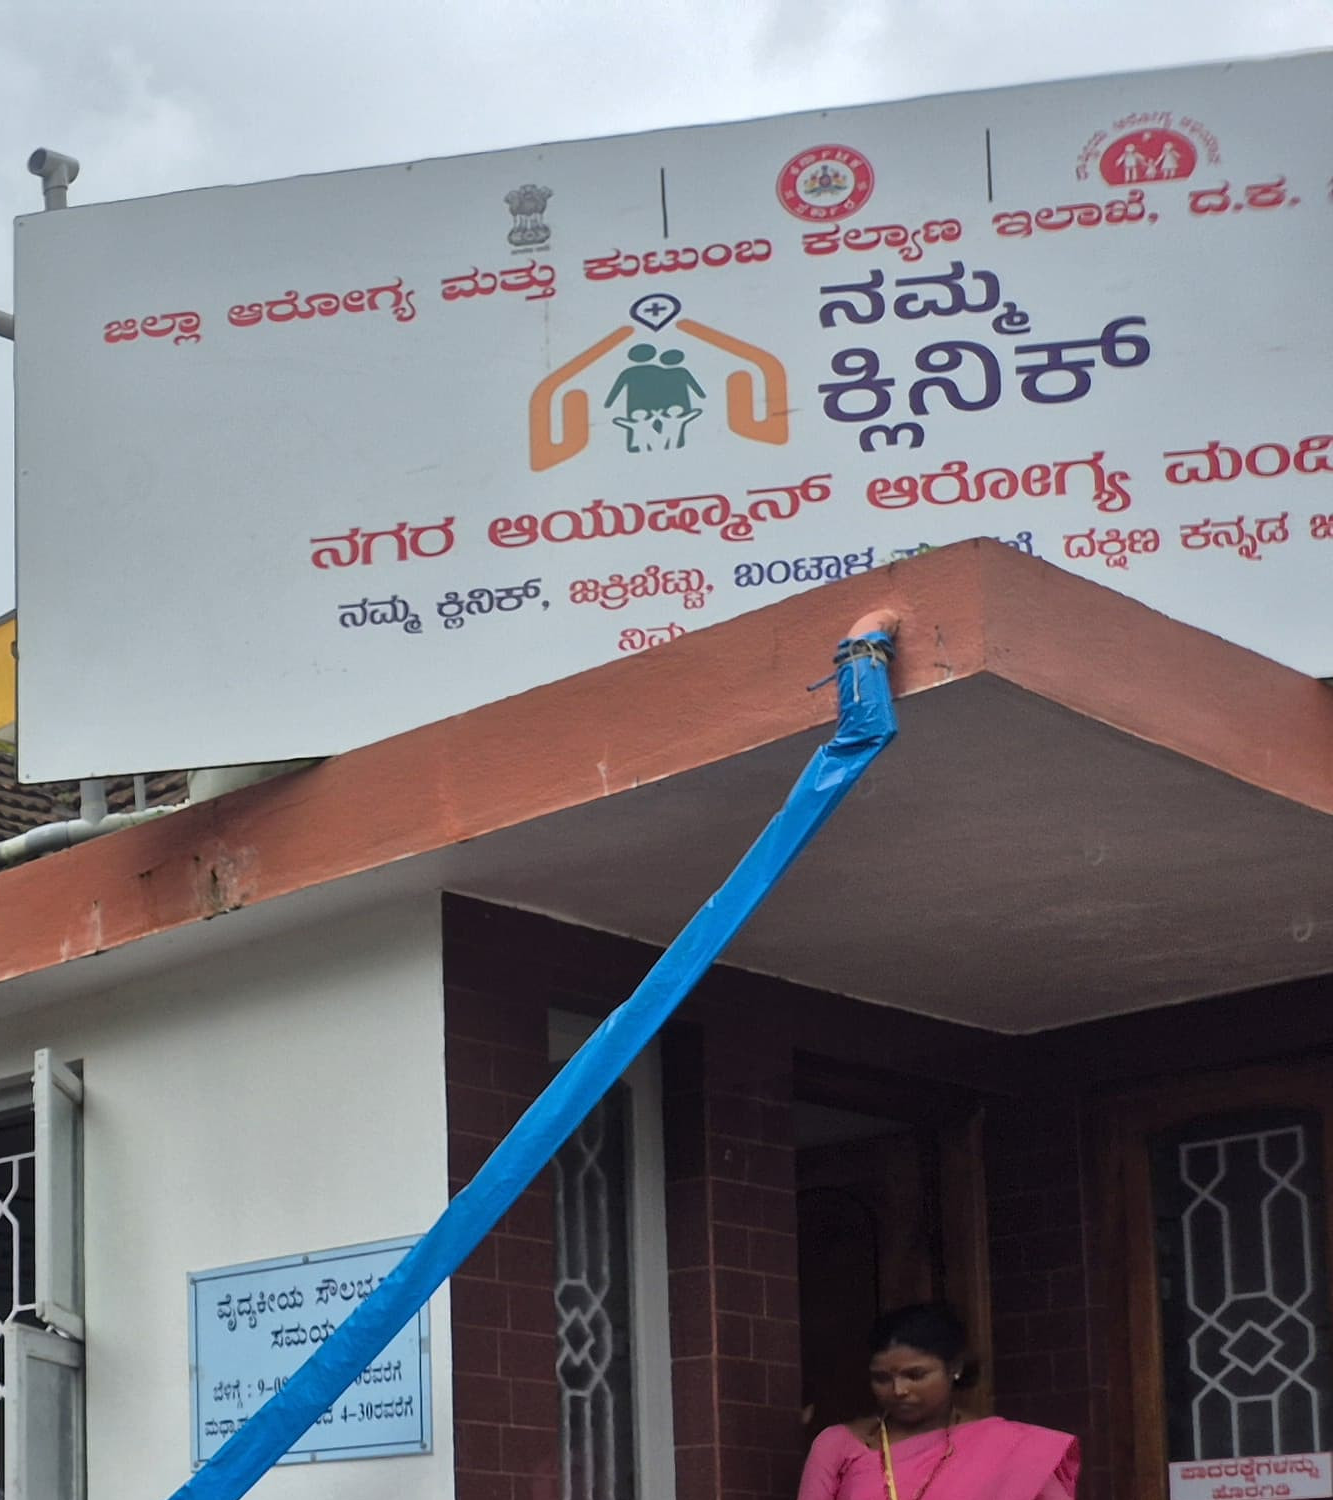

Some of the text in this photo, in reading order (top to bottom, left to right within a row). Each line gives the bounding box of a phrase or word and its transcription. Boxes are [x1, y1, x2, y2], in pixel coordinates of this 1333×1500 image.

[103, 310, 203, 346] ಜಿಲ್ಲಾ
[227, 277, 417, 323] ಆರೋಗ್ಯ
[441, 259, 558, 301] ಮತ್ತು
[583, 238, 773, 282] ಕುಟುಂಬ
[801, 217, 963, 263] ಕಲ್ಯಾಣ
[990, 188, 1159, 237] ಇಲಾಖೆ,
[818, 260, 1032, 335] ನಮ್ಮ
[817, 315, 1152, 453] ಕ್ಲಿನಿಕ್
[309, 515, 456, 570] ನಗರ
[487, 472, 833, 548] ಆಯುಷ್ಮಾನ್
[865, 450, 1133, 513] ಆರೋಗ್ಯ
[337, 595, 424, 633] ನಮ್ಮ
[435, 577, 551, 630] ಕ್ಲಿನಿಕ್,
[1062, 527, 1161, 570] ದಕ್ಷಿಣ
[1180, 511, 1290, 561] ಕನ್ನಡ
[216, 1286, 304, 1331] ವೈದ್ಯಕೀಯ
